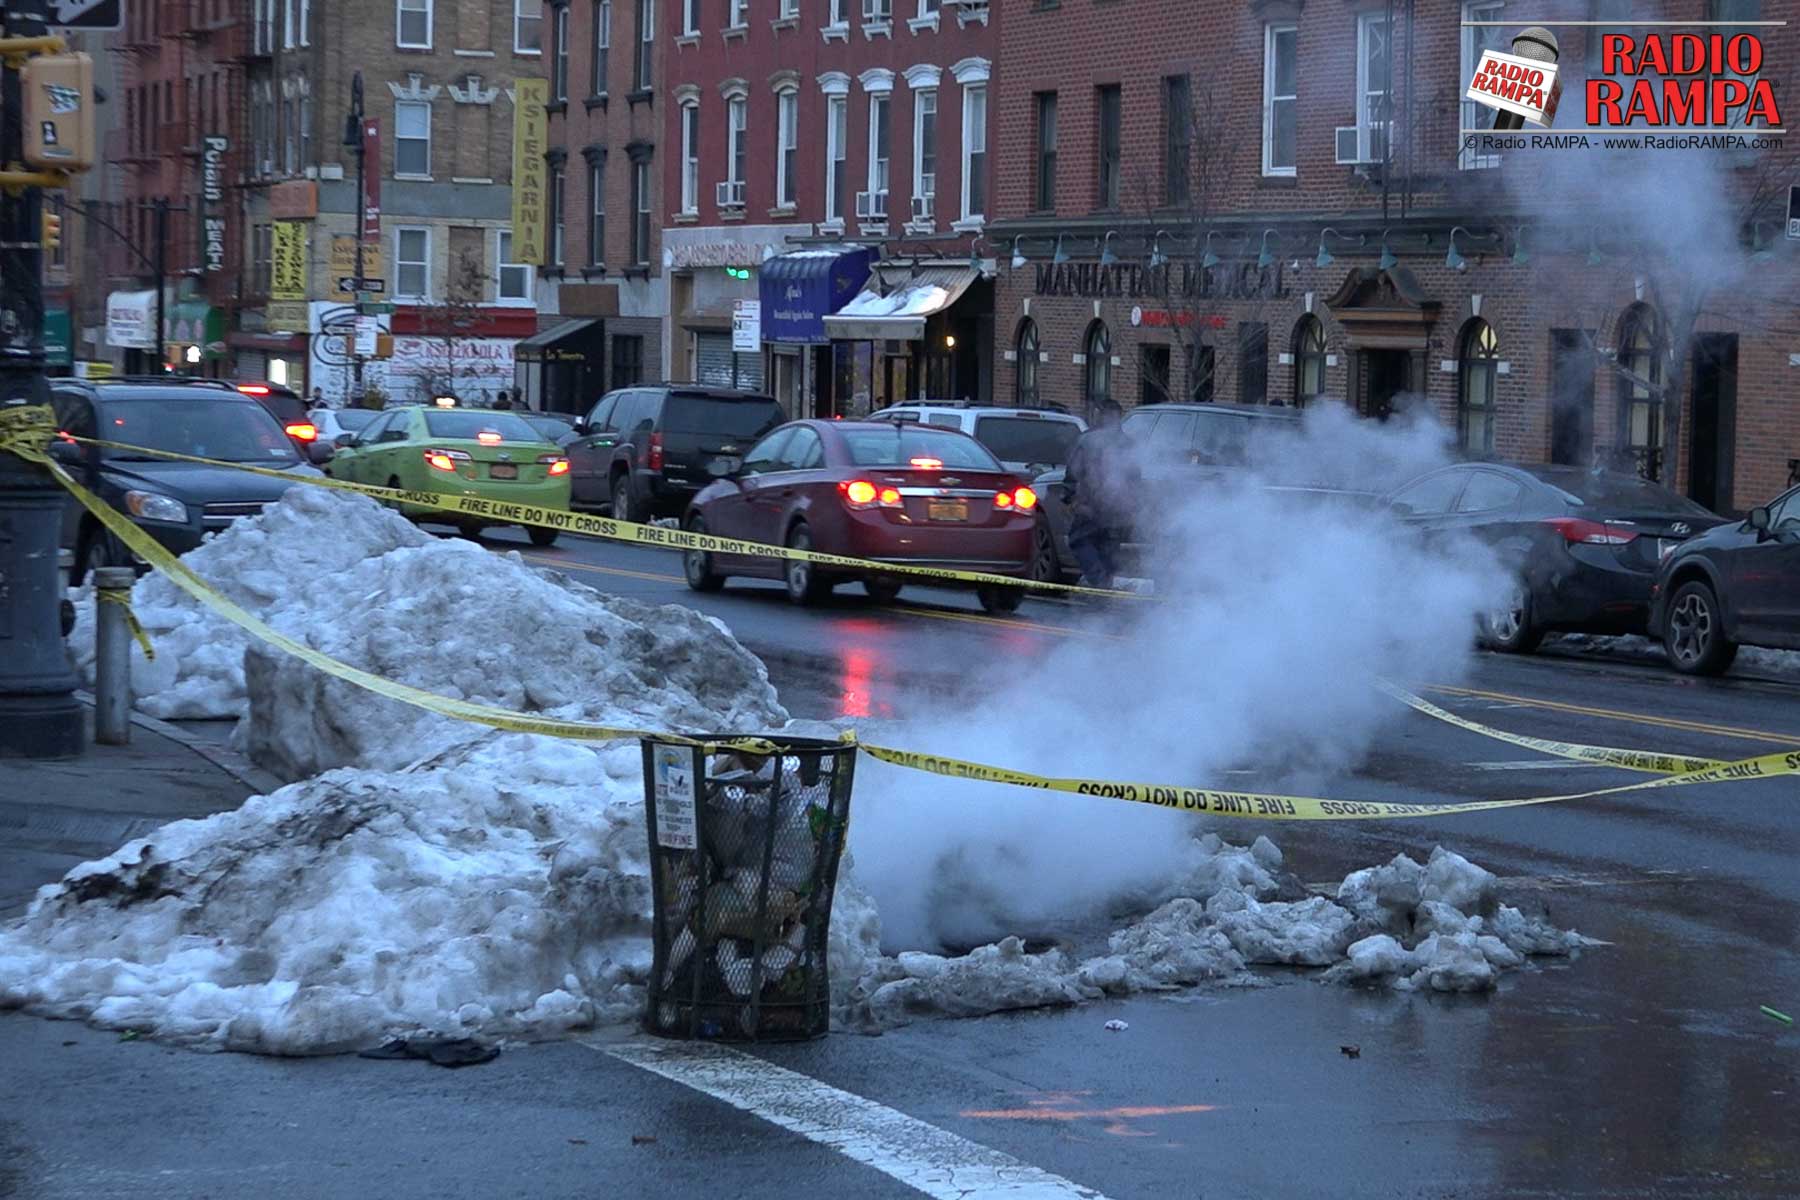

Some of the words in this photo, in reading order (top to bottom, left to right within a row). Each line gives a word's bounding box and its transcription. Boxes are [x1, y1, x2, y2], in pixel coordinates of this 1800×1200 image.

[1036, 262, 1170, 298] MANHATTAN
[396, 489, 440, 505] CROSS
[459, 498, 489, 515] FIRE
[492, 502, 521, 519] LINE
[524, 508, 542, 523] DO
[546, 511, 573, 528] NOT
[576, 516, 617, 536] CROSS
[637, 526, 665, 542] FIRE
[668, 530, 696, 547] LINE
[699, 536, 717, 550] DO
[720, 540, 744, 555] NOT
[749, 545, 789, 559] CROSS
[1723, 761, 1764, 780] FIRE
[1078, 782, 1137, 801] CROSS
[1145, 786, 1181, 807] NOT
[1184, 790, 1208, 810] DO
[1213, 794, 1251, 814] LINE
[1257, 797, 1296, 816] FIRE
[1319, 800, 1380, 816] CROSS
